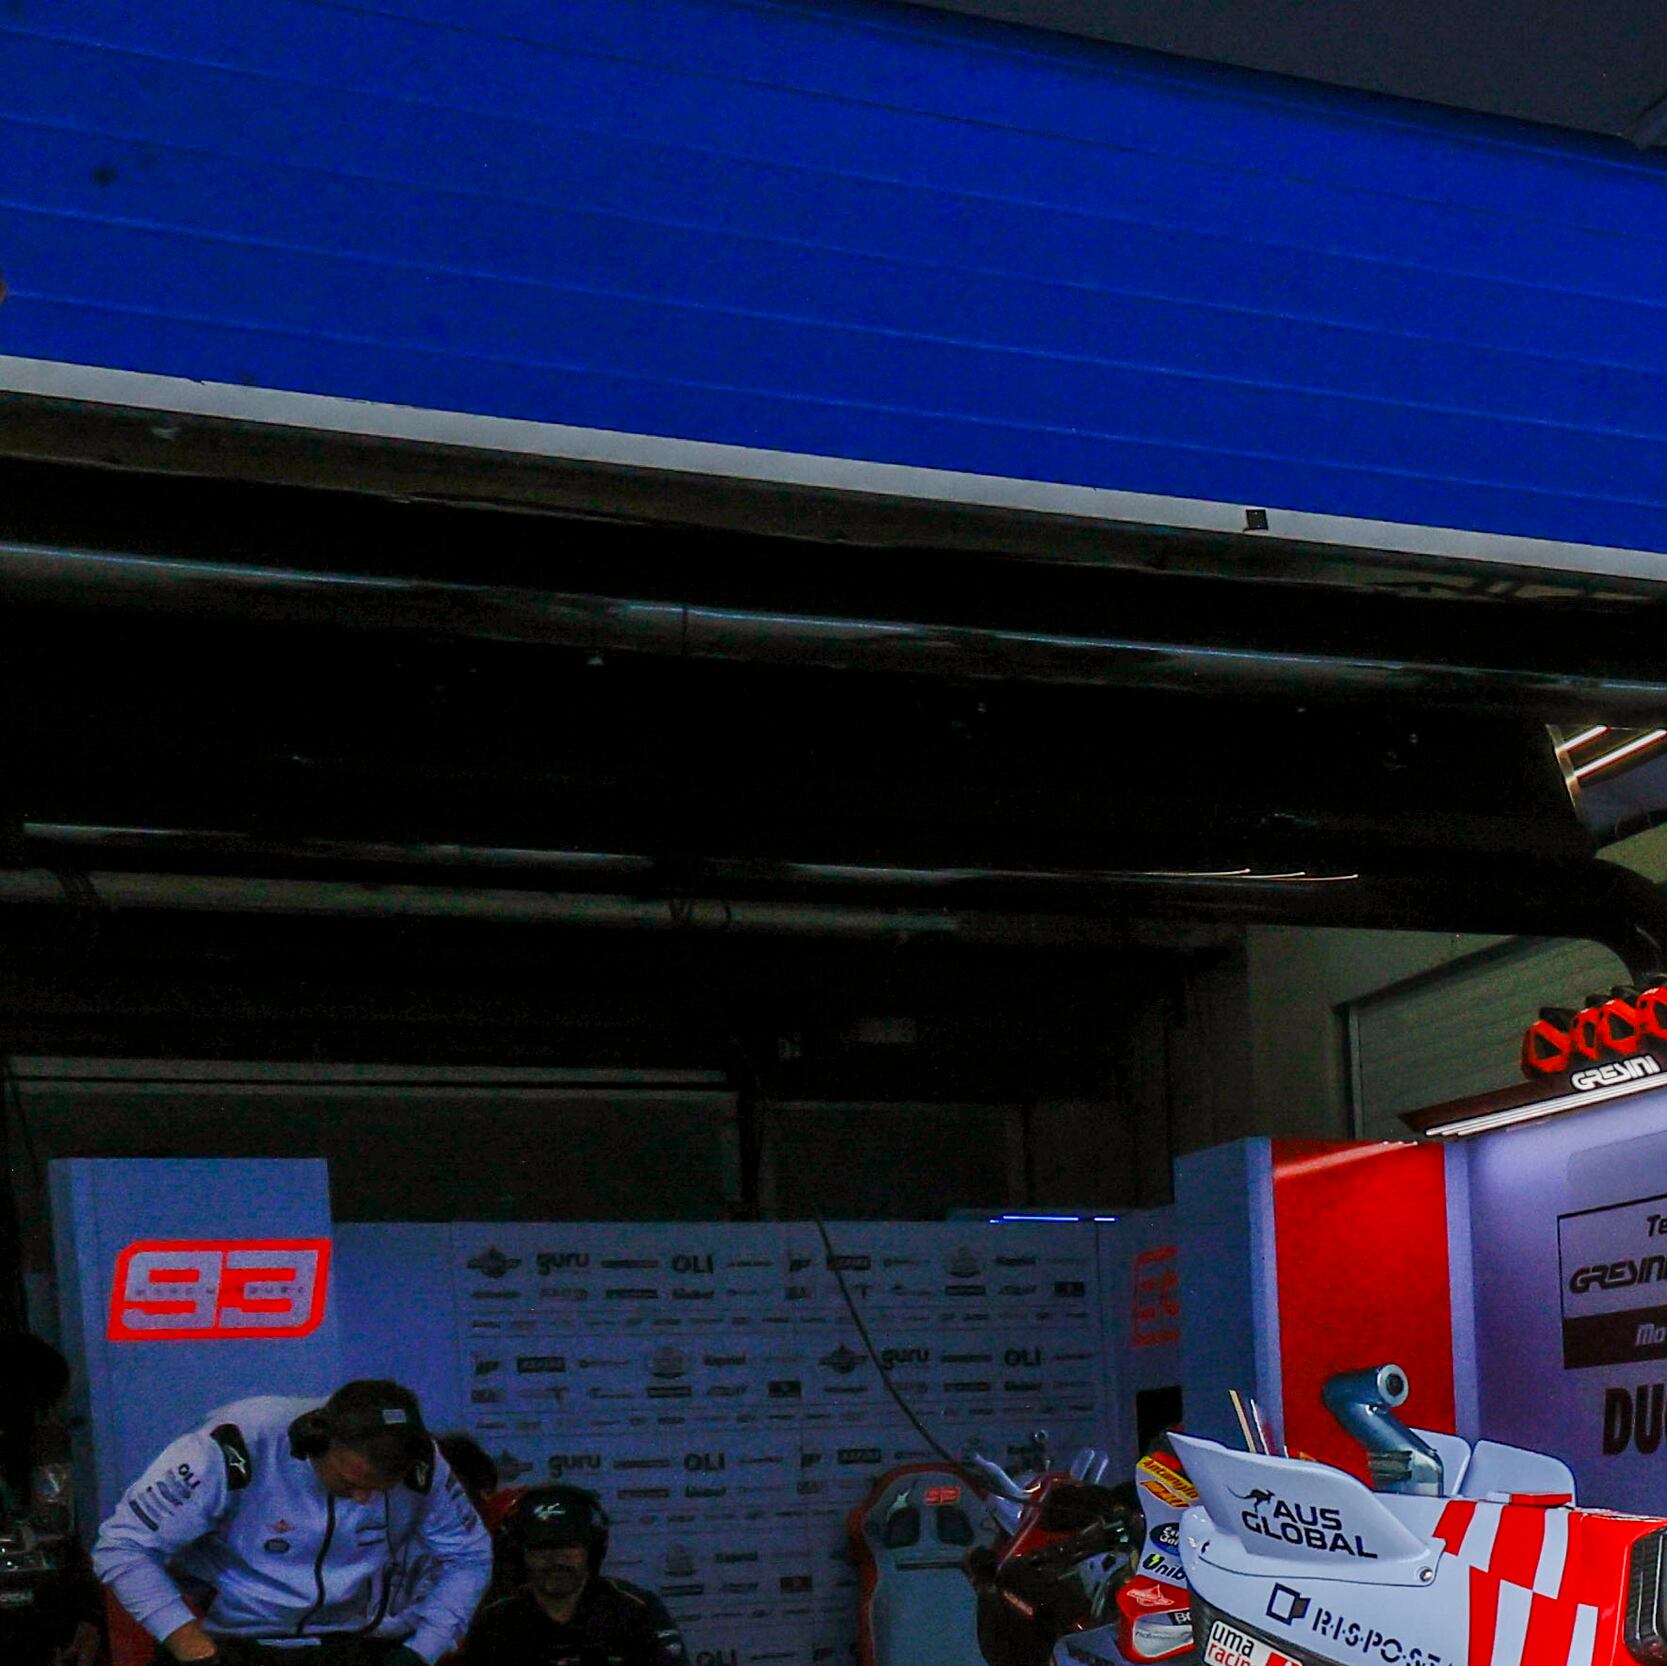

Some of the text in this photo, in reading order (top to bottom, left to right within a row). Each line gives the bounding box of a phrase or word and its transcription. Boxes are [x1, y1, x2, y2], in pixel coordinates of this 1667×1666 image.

[536, 1252, 590, 1276] guru
[671, 1253, 715, 1274] OLI
[118, 1248, 322, 1330] 93
[880, 1347, 930, 1370] guru
[1003, 1346, 1042, 1367] OLI
[547, 1453, 602, 1478] guru
[683, 1452, 726, 1471] OLI
[1272, 1499, 1344, 1532] AUS
[1241, 1509, 1379, 1560] GLOBAL
[1142, 1552, 1187, 1583] Unib
[1211, 1622, 1256, 1656] uma
